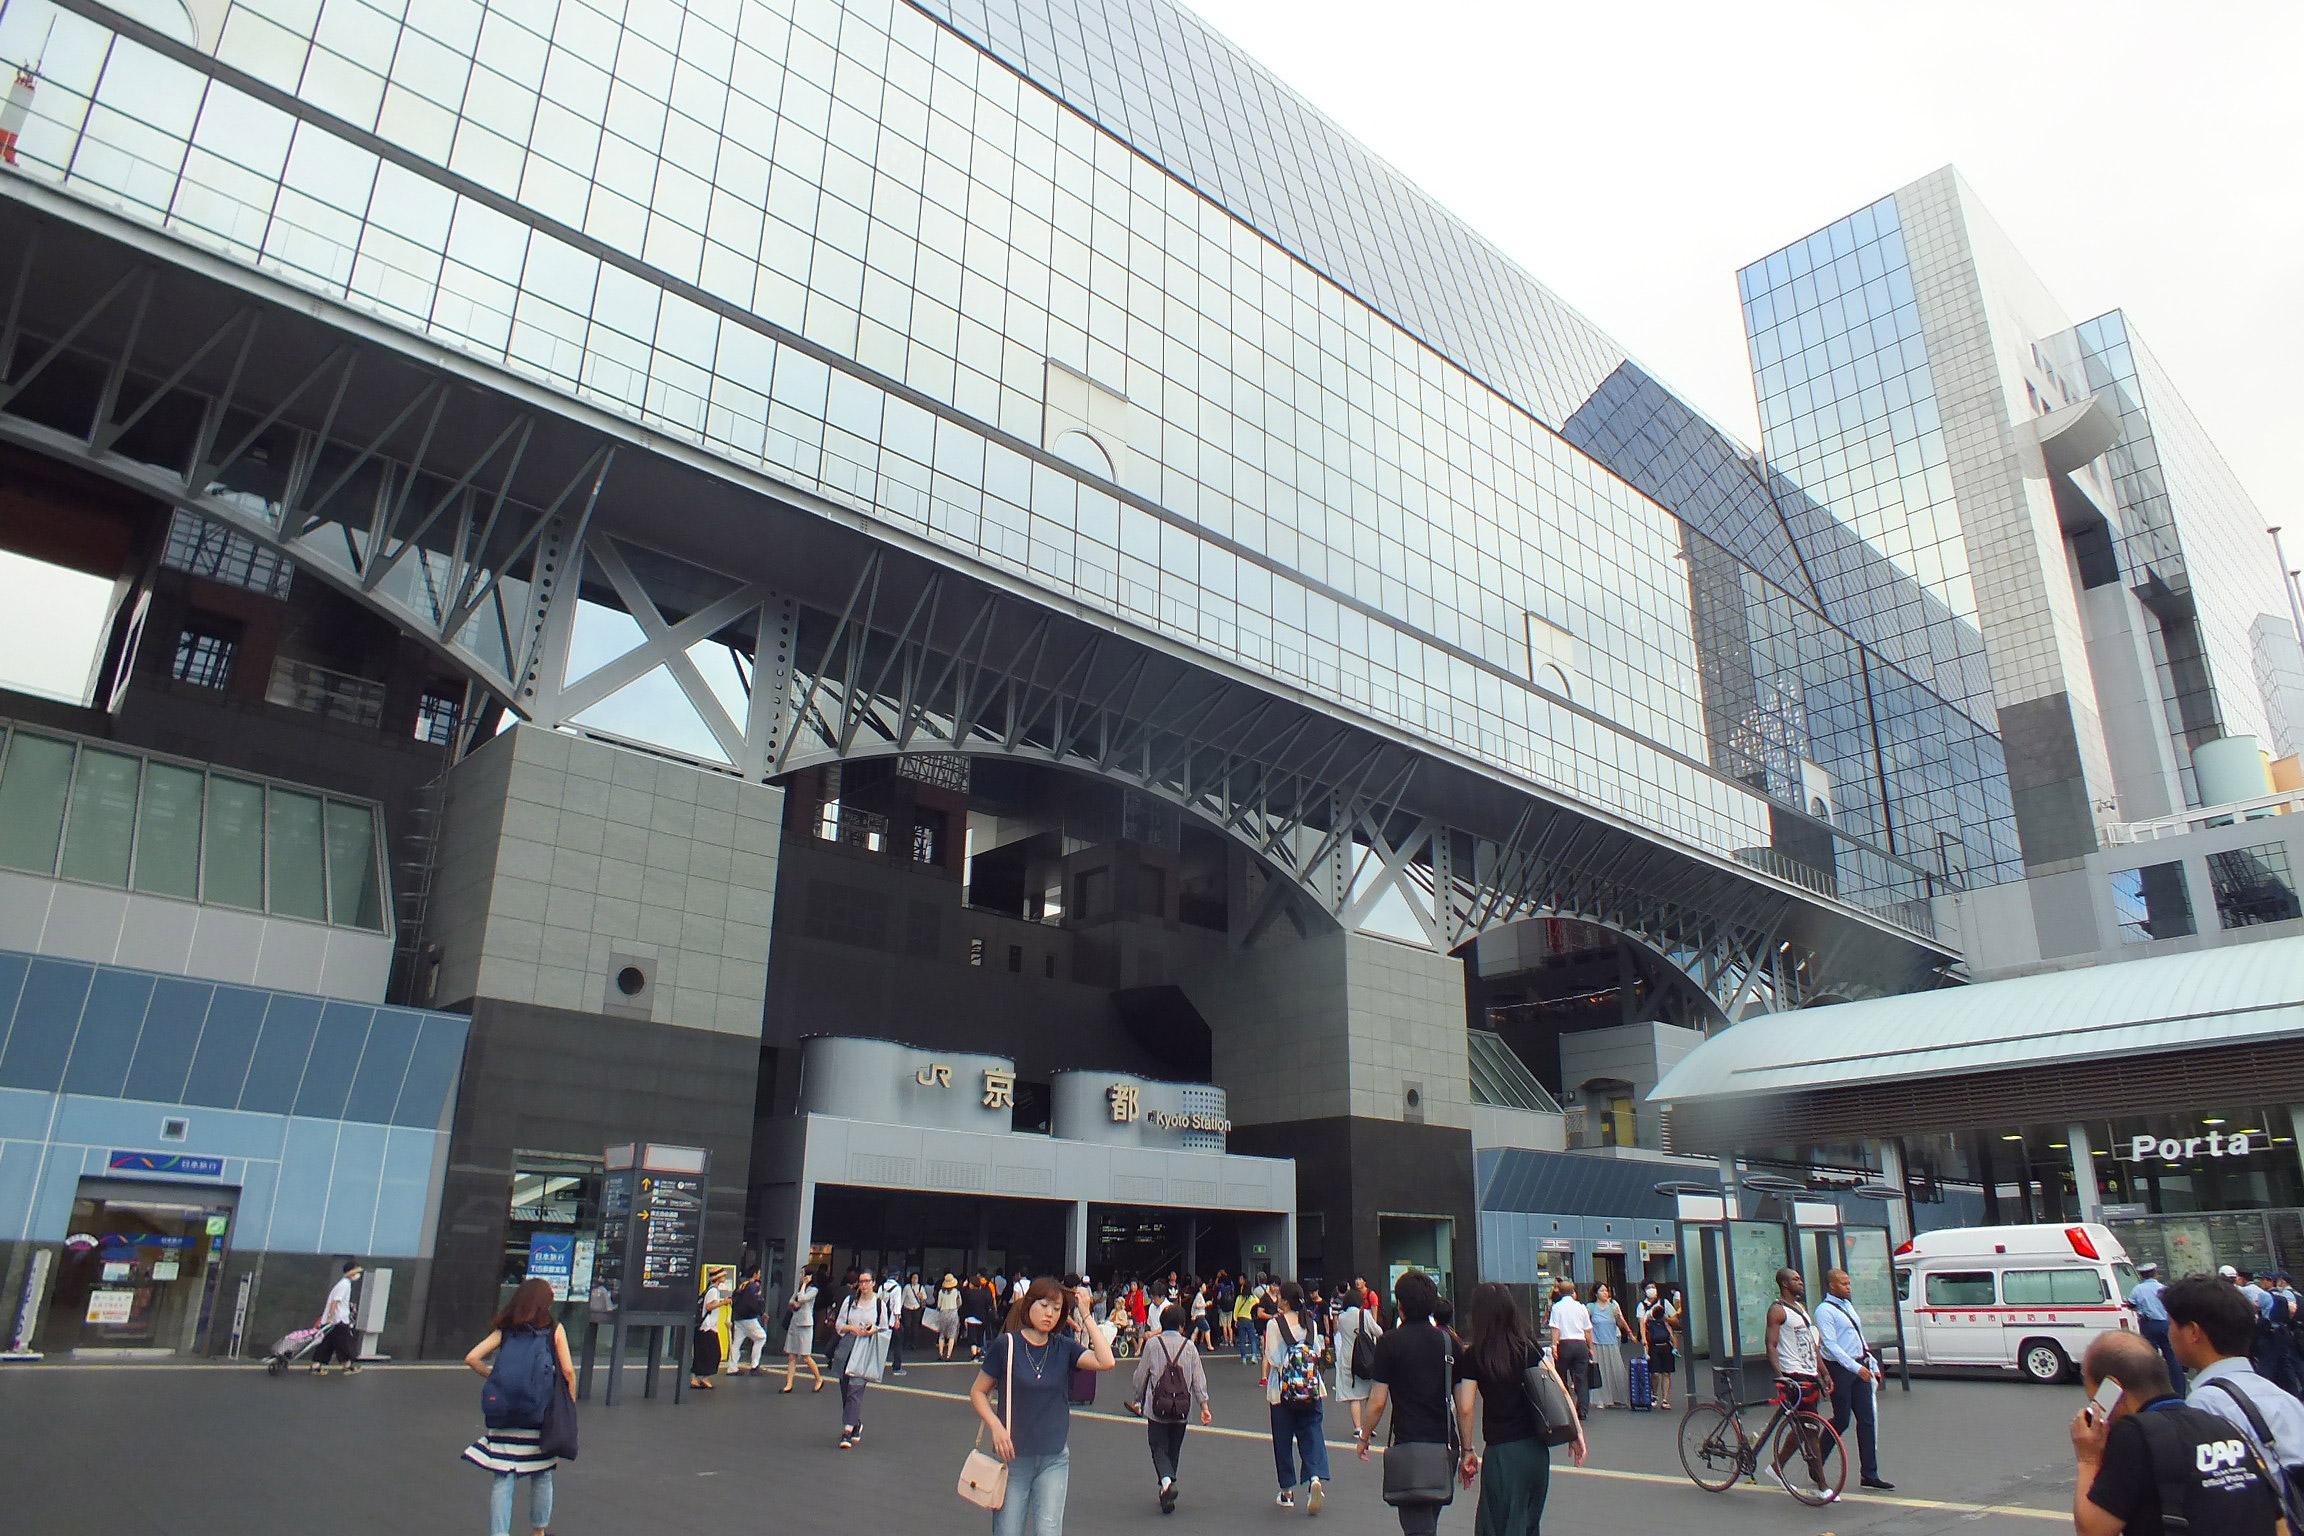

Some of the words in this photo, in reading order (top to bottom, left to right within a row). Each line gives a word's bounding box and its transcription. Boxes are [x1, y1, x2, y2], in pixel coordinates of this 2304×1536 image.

[916, 1063, 951, 1089] JR
[1155, 1109, 1191, 1131] Kyoto
[1192, 1114, 1232, 1133] Station
[2132, 1130, 2249, 1162] Porta
[181, 1159, 217, 1170] 日本旅行
[534, 1252, 565, 1262] 日本旅行
[2196, 1440, 2246, 1472] CAP
